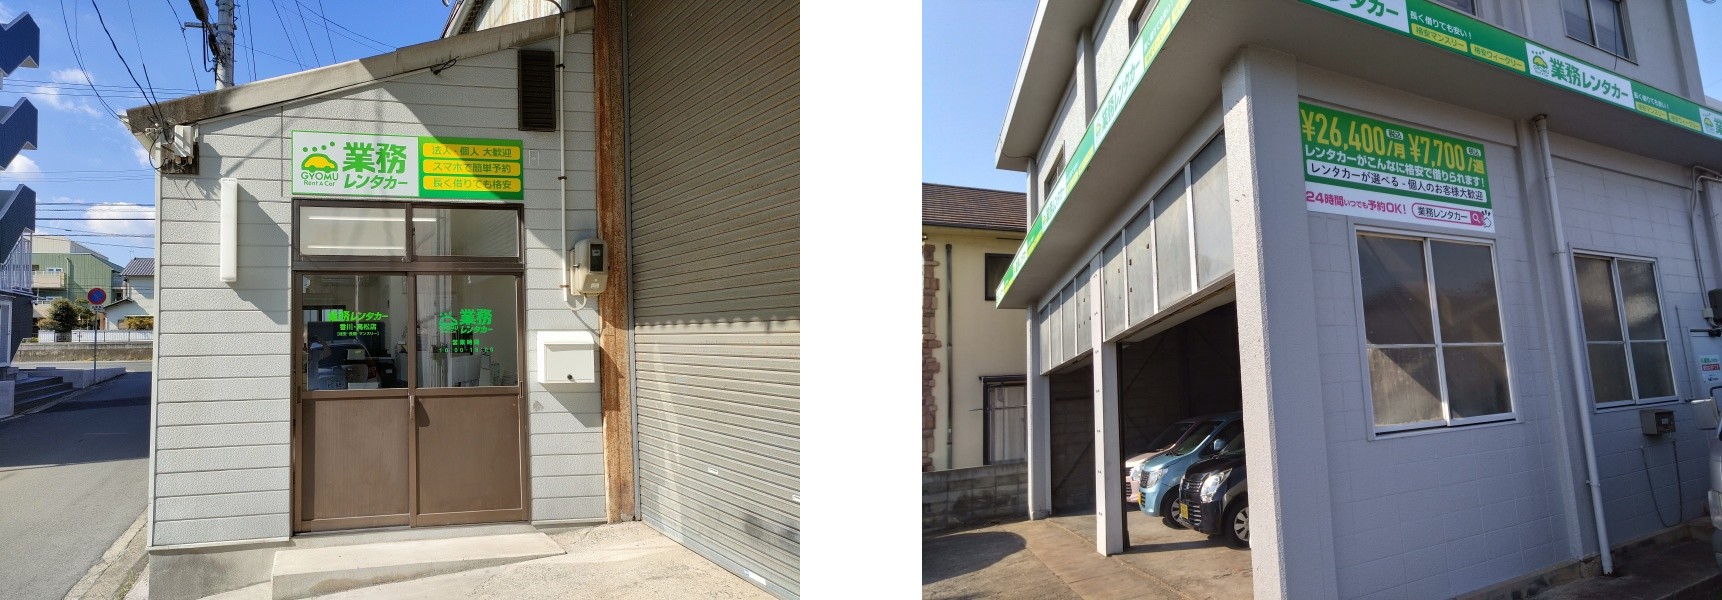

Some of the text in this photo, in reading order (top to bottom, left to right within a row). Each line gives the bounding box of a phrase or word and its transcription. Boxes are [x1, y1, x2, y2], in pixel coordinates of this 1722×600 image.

[1416, 26, 1465, 47] 格安マンスリー
[1549, 56, 1629, 99] 業務レンタカー
[342, 142, 407, 174] 業務
[1305, 144, 1485, 187] レンタカーがこんなに格安で借りられます!
[301, 171, 339, 181] GYOMU
[433, 162, 511, 174] スマホで簡単予約
[343, 174, 408, 189] レンタカー
[433, 178, 512, 190] 長く借りても格安
[1305, 190, 1407, 215] 24時間いつでも予約OK!
[1417, 206, 1468, 221] 業務レンタカー
[459, 308, 493, 325] 業務
[460, 325, 494, 334] レンタカー
